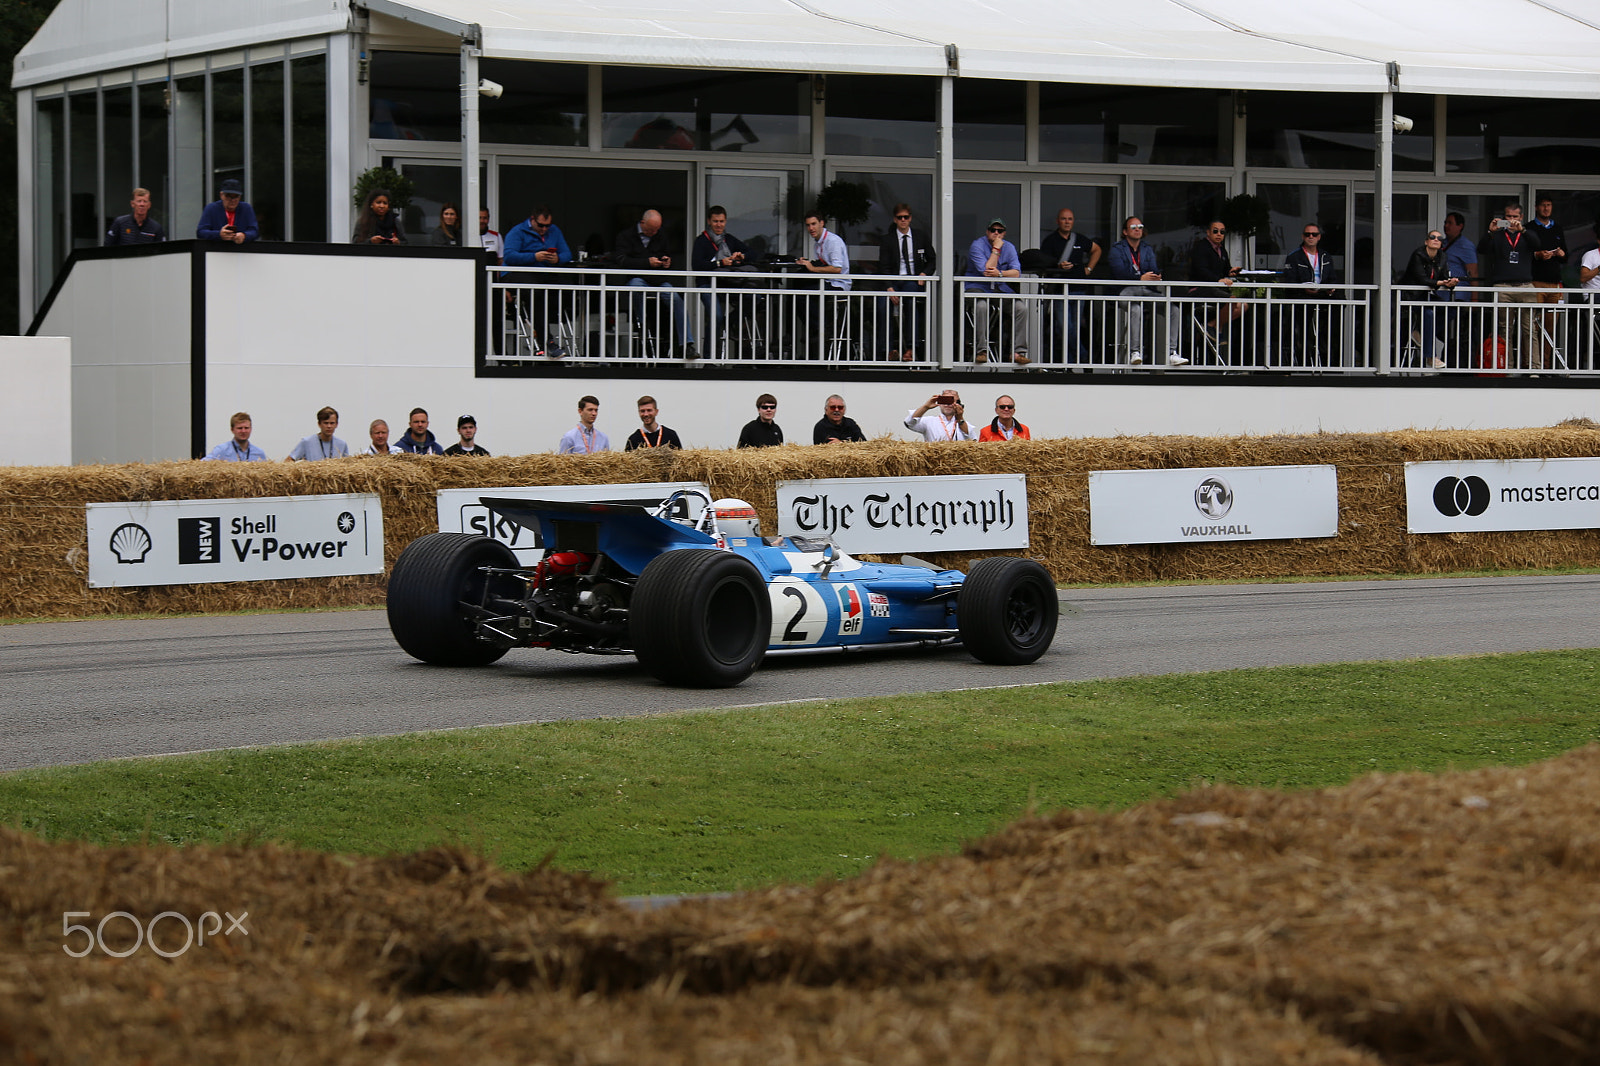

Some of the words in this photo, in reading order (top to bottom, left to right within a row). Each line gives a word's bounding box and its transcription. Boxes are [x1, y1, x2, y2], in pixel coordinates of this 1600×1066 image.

[1501, 483, 1599, 502] masterca
[231, 515, 276, 534] Shell
[792, 495, 854, 534] The
[863, 490, 1013, 535] Telegraph
[470, 508, 521, 546] sky
[1181, 525, 1252, 536] VAUXHALL
[199, 520, 213, 560] NEW
[231, 537, 348, 562] V-Power
[782, 587, 807, 641] 2
[843, 618, 860, 632] elf
